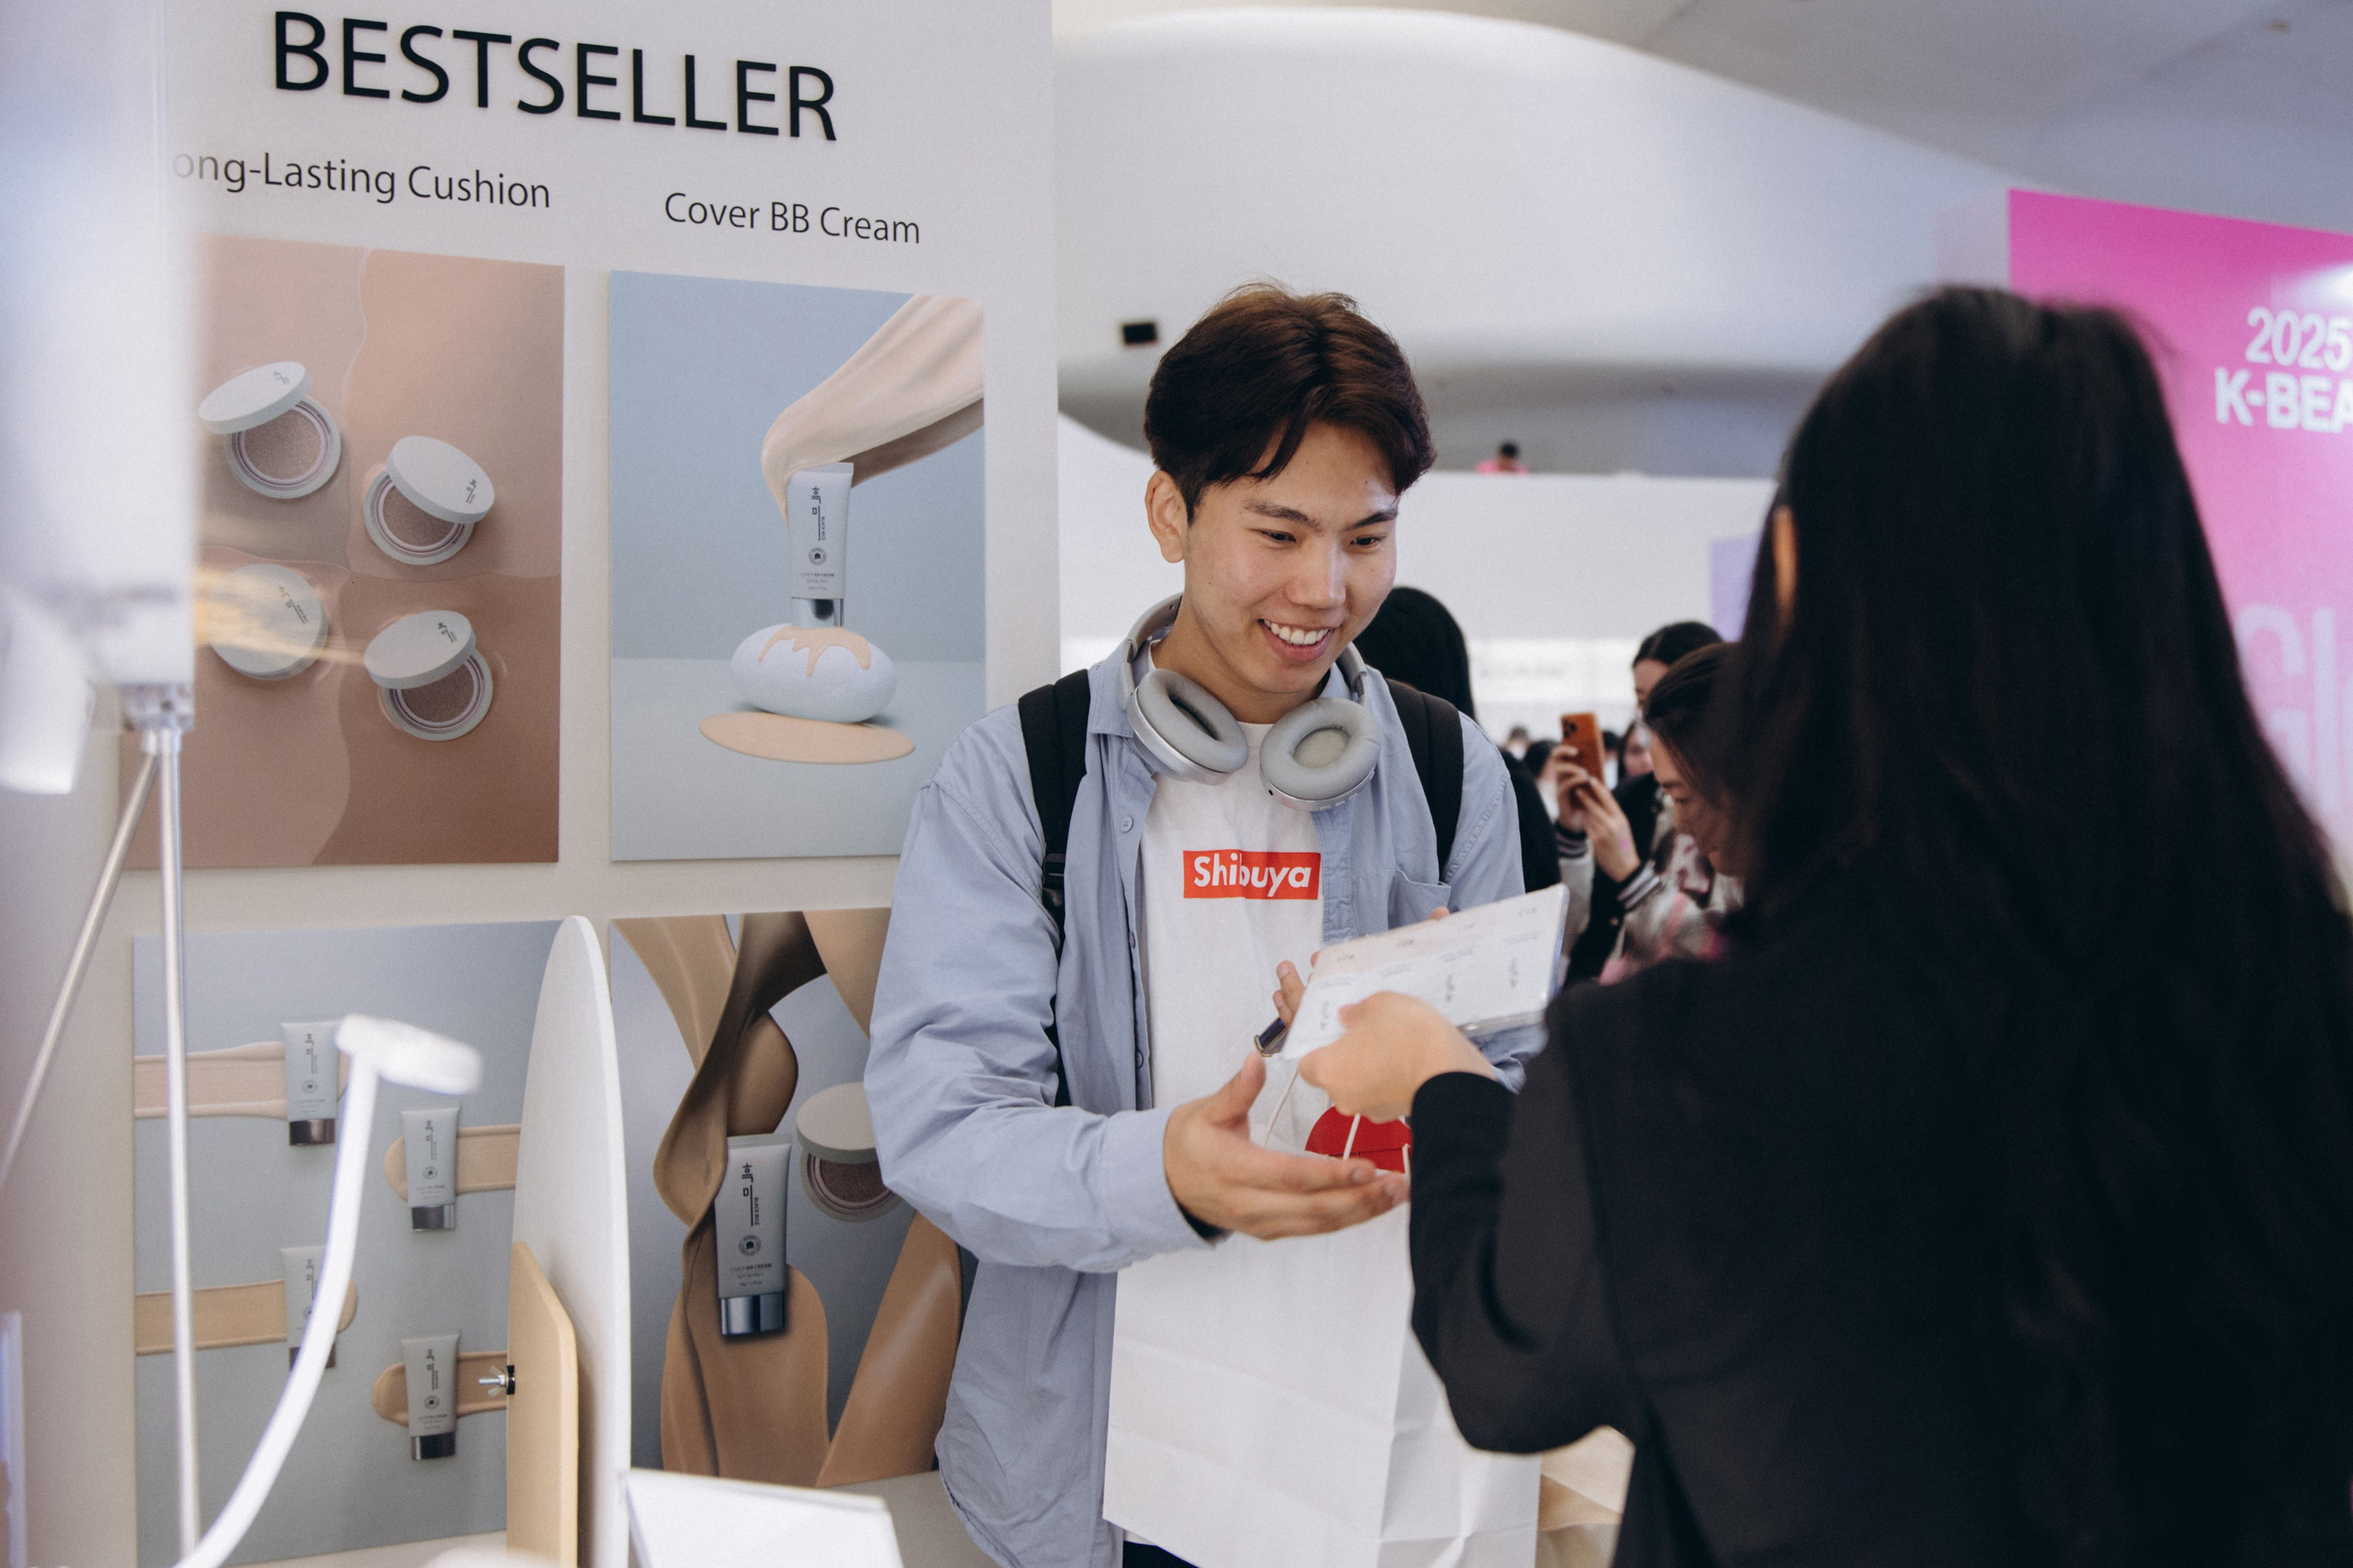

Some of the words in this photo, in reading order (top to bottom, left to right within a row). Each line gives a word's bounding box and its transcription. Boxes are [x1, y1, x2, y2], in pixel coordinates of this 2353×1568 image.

[274, 10, 837, 142] BESTSELLER
[172, 152, 396, 205] ong-Lasting
[407, 165, 551, 209] Cushion
[665, 192, 760, 229] Cover
[771, 200, 810, 233] BB
[820, 206, 920, 244] Cream
[2245, 306, 2353, 372] 2025
[2234, 602, 2353, 813] Gl
[1193, 852, 1312, 898] Shibuya
